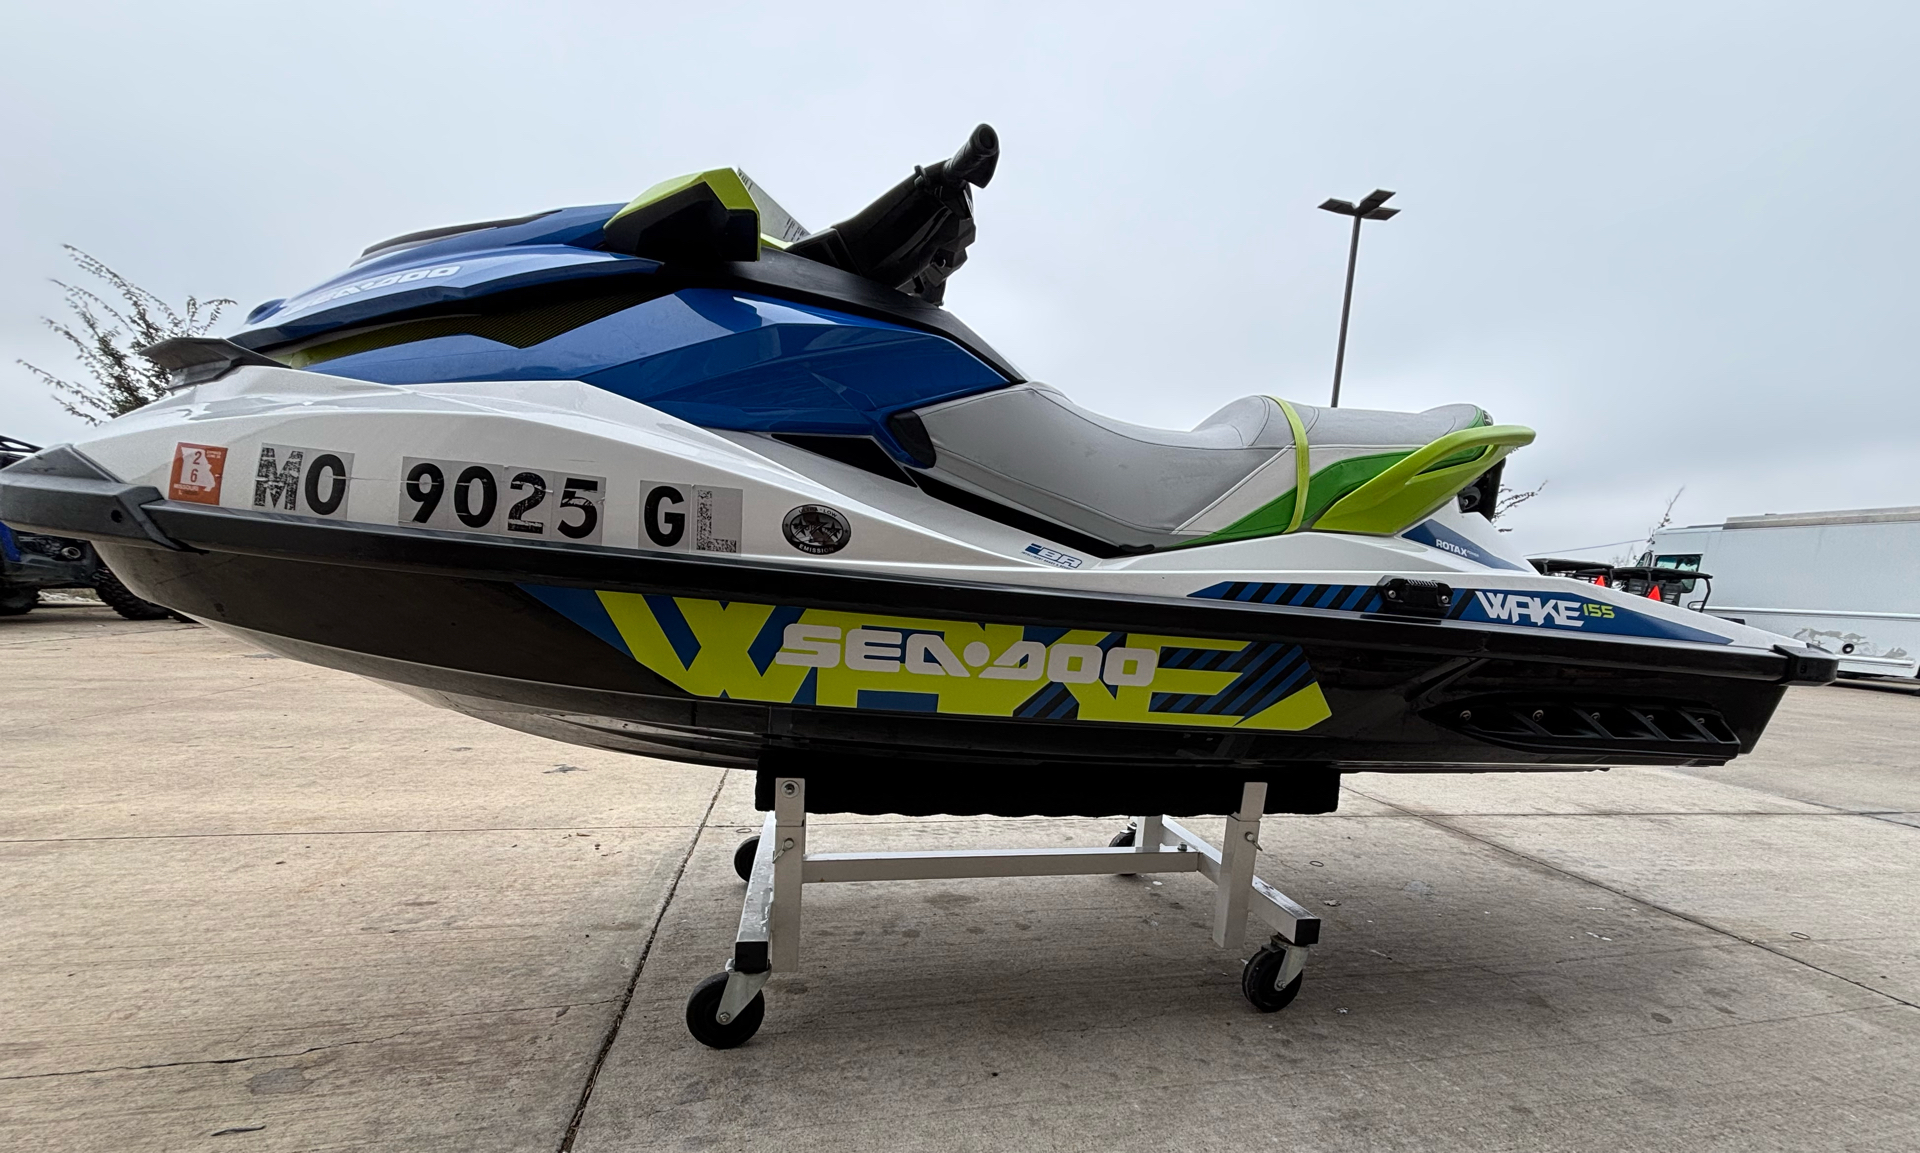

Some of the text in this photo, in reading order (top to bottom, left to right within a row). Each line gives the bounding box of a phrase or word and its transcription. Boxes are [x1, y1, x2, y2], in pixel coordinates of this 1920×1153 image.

[193, 450, 202, 465] 2
[190, 468, 199, 483] 6
[406, 462, 599, 540] 9025
[798, 543, 834, 554] EMISSION
[1436, 538, 1468, 557] ROTAX
[1475, 590, 1615, 627] WAKE 155
